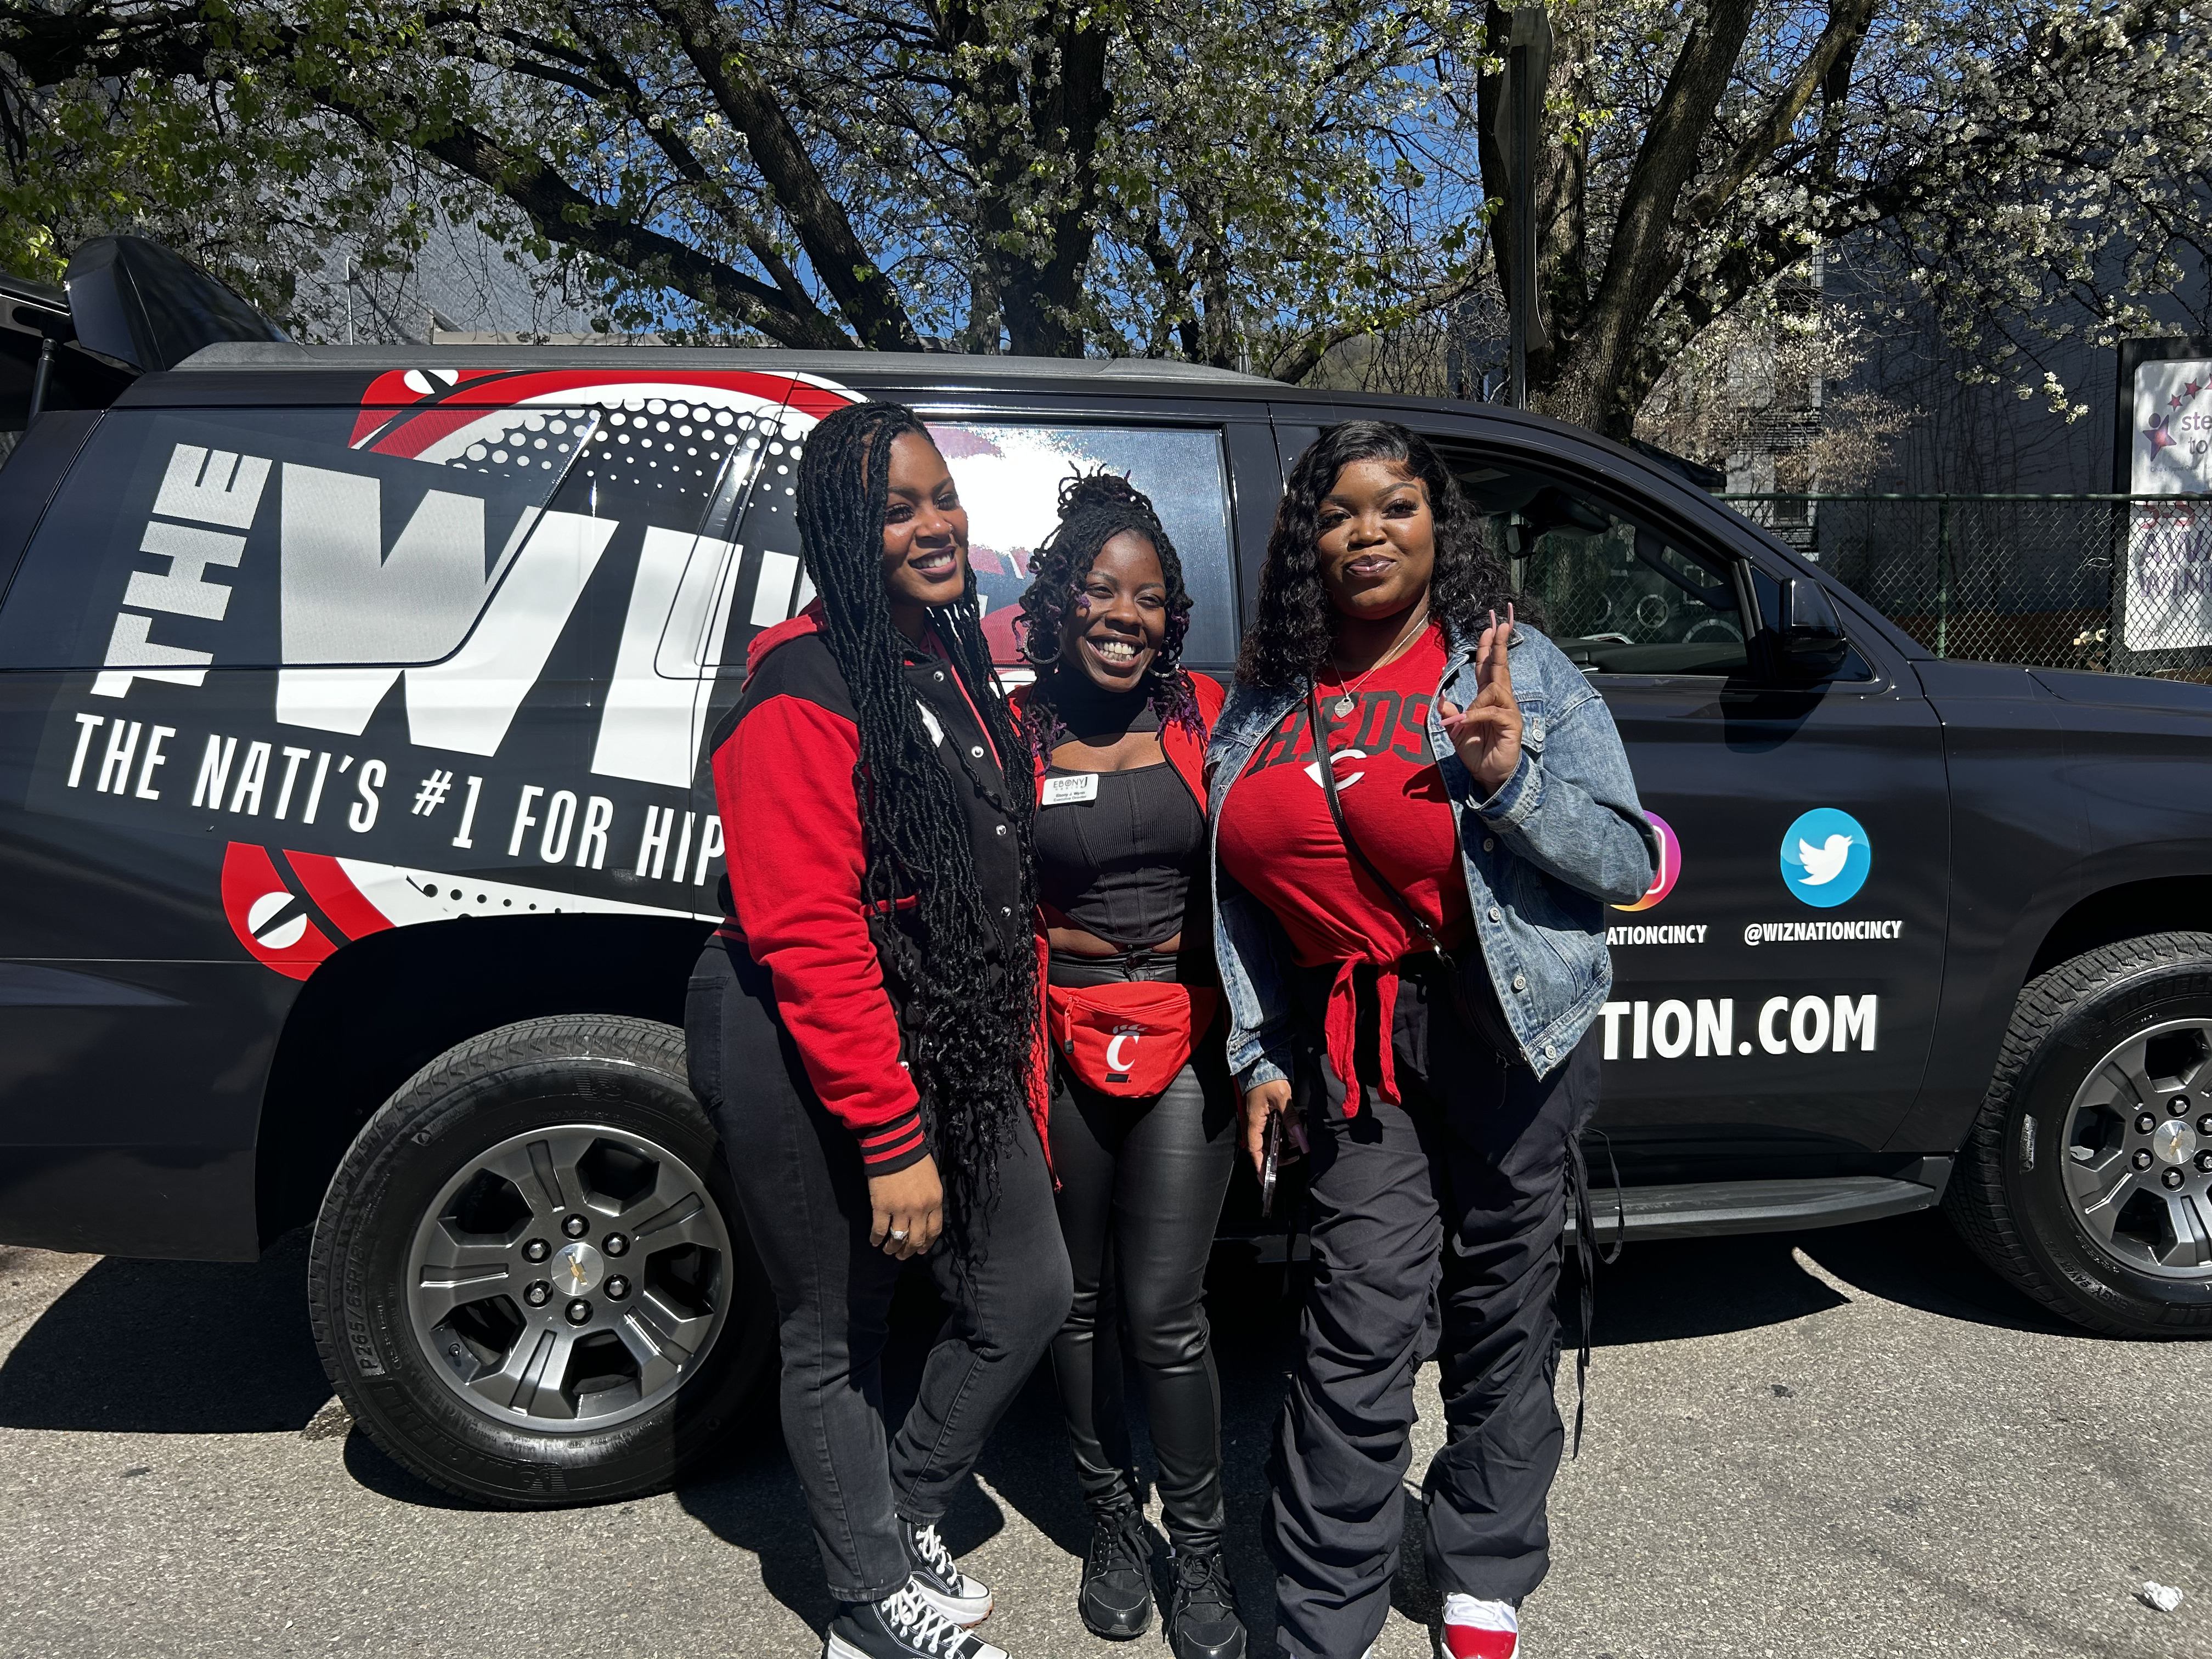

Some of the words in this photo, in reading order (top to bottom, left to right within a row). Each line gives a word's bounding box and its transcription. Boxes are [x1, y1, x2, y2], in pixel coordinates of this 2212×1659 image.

[2187, 436, 2208, 455] to
[89, 442, 273, 698] THE
[2137, 567, 2212, 597] WIN
[1243, 690, 1438, 778] REDS
[67, 713, 177, 800] THE
[191, 734, 387, 833] NATI'S
[411, 769, 483, 849] #1
[508, 785, 613, 870] FOR
[635, 805, 725, 886] HIP
[1605, 924, 1707, 945] ATIONCINCY
[1744, 920, 1902, 946] @WIZNATIONCINCY
[1598, 994, 1877, 1060] TION.COM
[346, 1244, 379, 1370] P265/65R18
